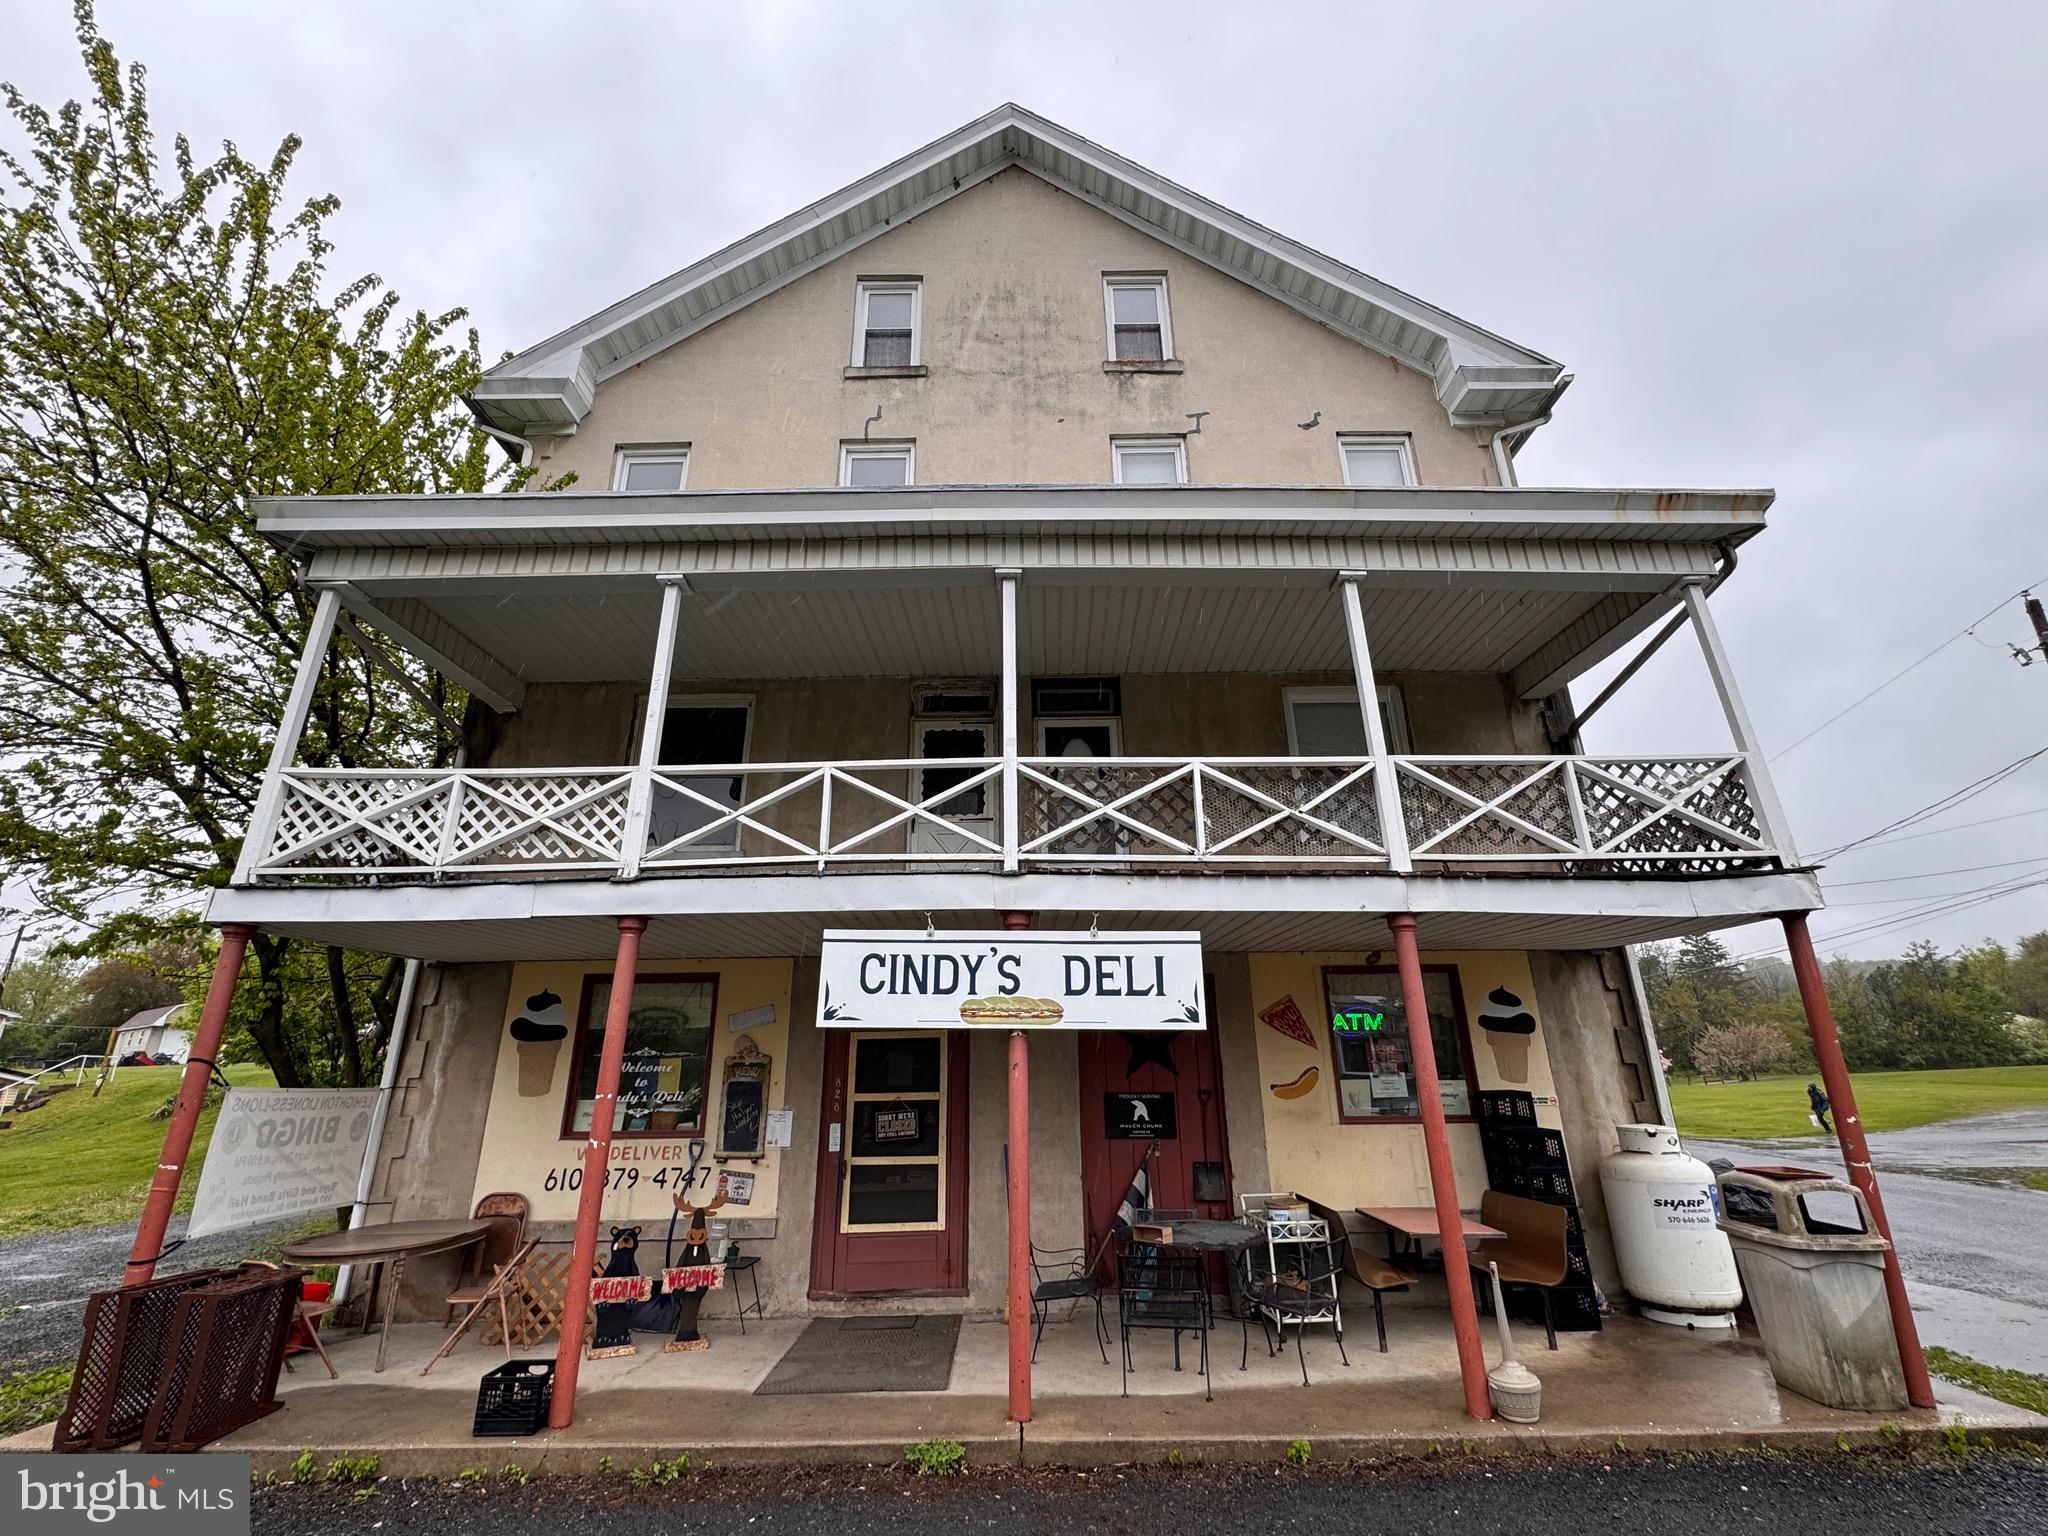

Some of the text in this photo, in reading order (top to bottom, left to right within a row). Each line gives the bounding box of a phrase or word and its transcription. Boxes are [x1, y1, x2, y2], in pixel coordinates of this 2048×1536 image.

[859, 947, 1167, 997] CINDY'S DELI
[1333, 1012, 1383, 1031] ATM
[621, 1061, 674, 1073] Welcome
[634, 1077, 649, 1088] to
[652, 1090, 685, 1105] Deli
[877, 1119, 916, 1133] CLOSED
[544, 1167, 583, 1192] 610
[652, 1167, 712, 1190] 4747
[1653, 1198, 1705, 1211] SHARP
[667, 1268, 719, 1290] WELCOME
[592, 1279, 646, 1300] WELCOME
